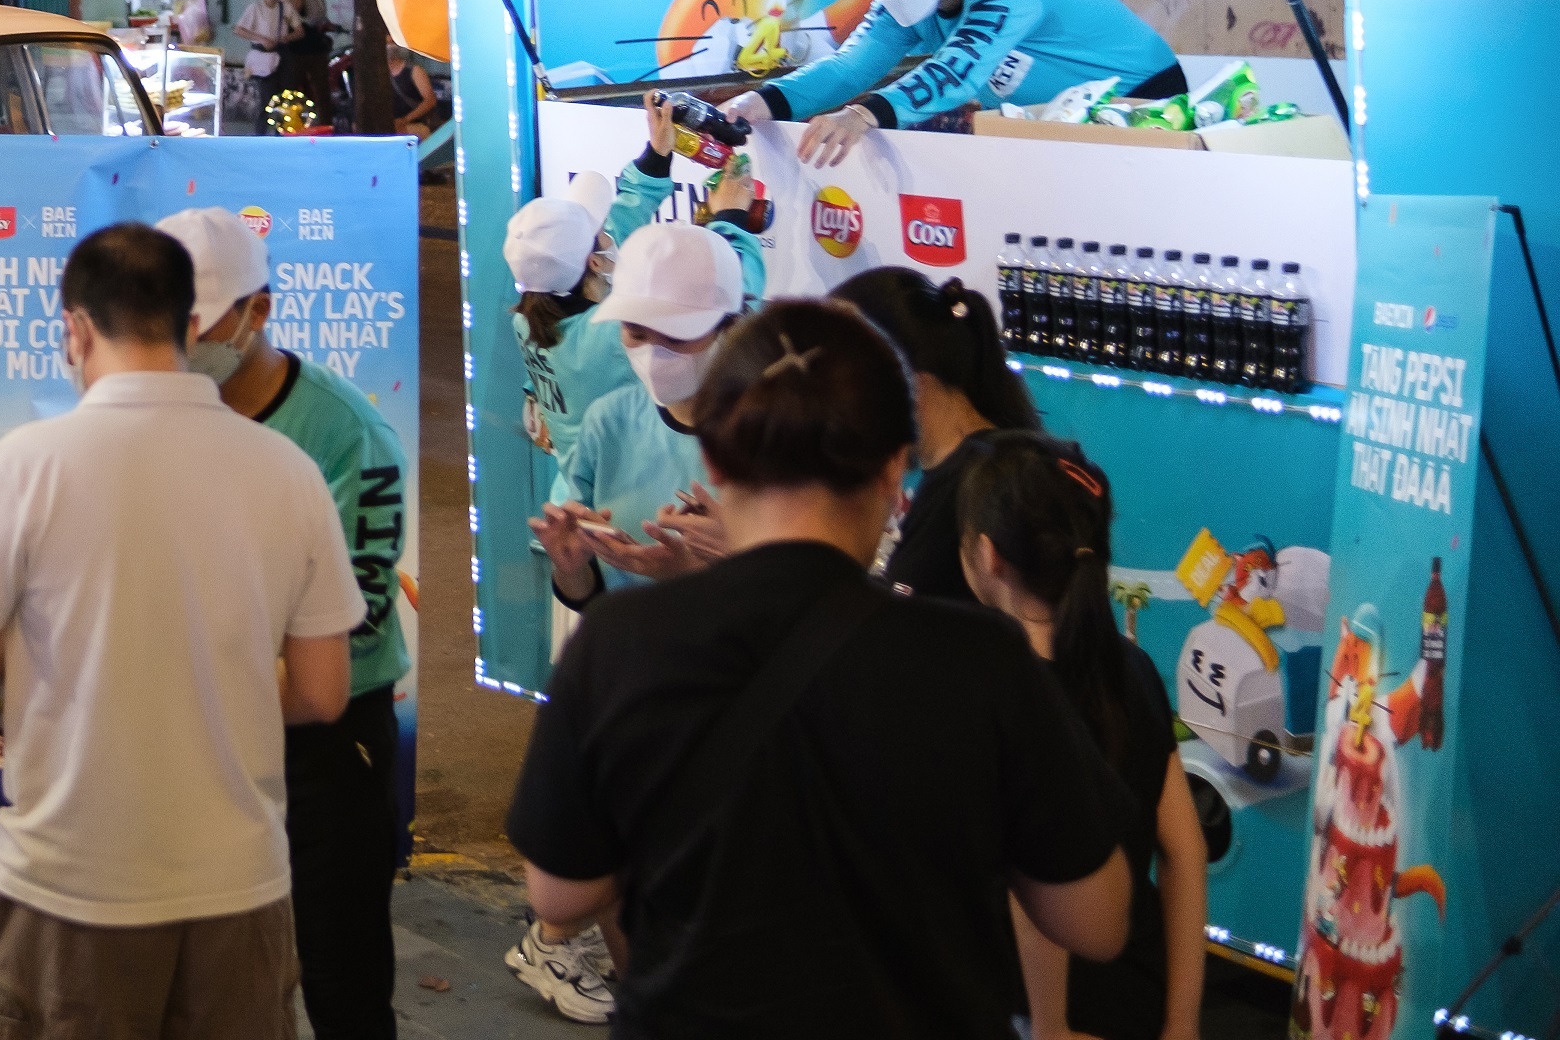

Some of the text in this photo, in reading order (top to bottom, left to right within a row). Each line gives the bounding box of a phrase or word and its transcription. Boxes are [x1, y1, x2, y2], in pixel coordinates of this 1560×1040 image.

[41, 207, 77, 222] BAE
[298, 208, 334, 224] BAE
[41, 223, 77, 238] MIN
[298, 225, 335, 241] MIN
[907, 219, 958, 248] COSY
[27, 256, 69, 286] NH
[275, 262, 374, 291] SNACK
[324, 291, 406, 320] LAY'S
[318, 321, 394, 350] NHẬT
[6, 350, 71, 380] MỪN
[1403, 350, 1467, 408] PEPSI
[1367, 395, 1417, 451] SINH
[1414, 406, 1473, 465] NHẬT
